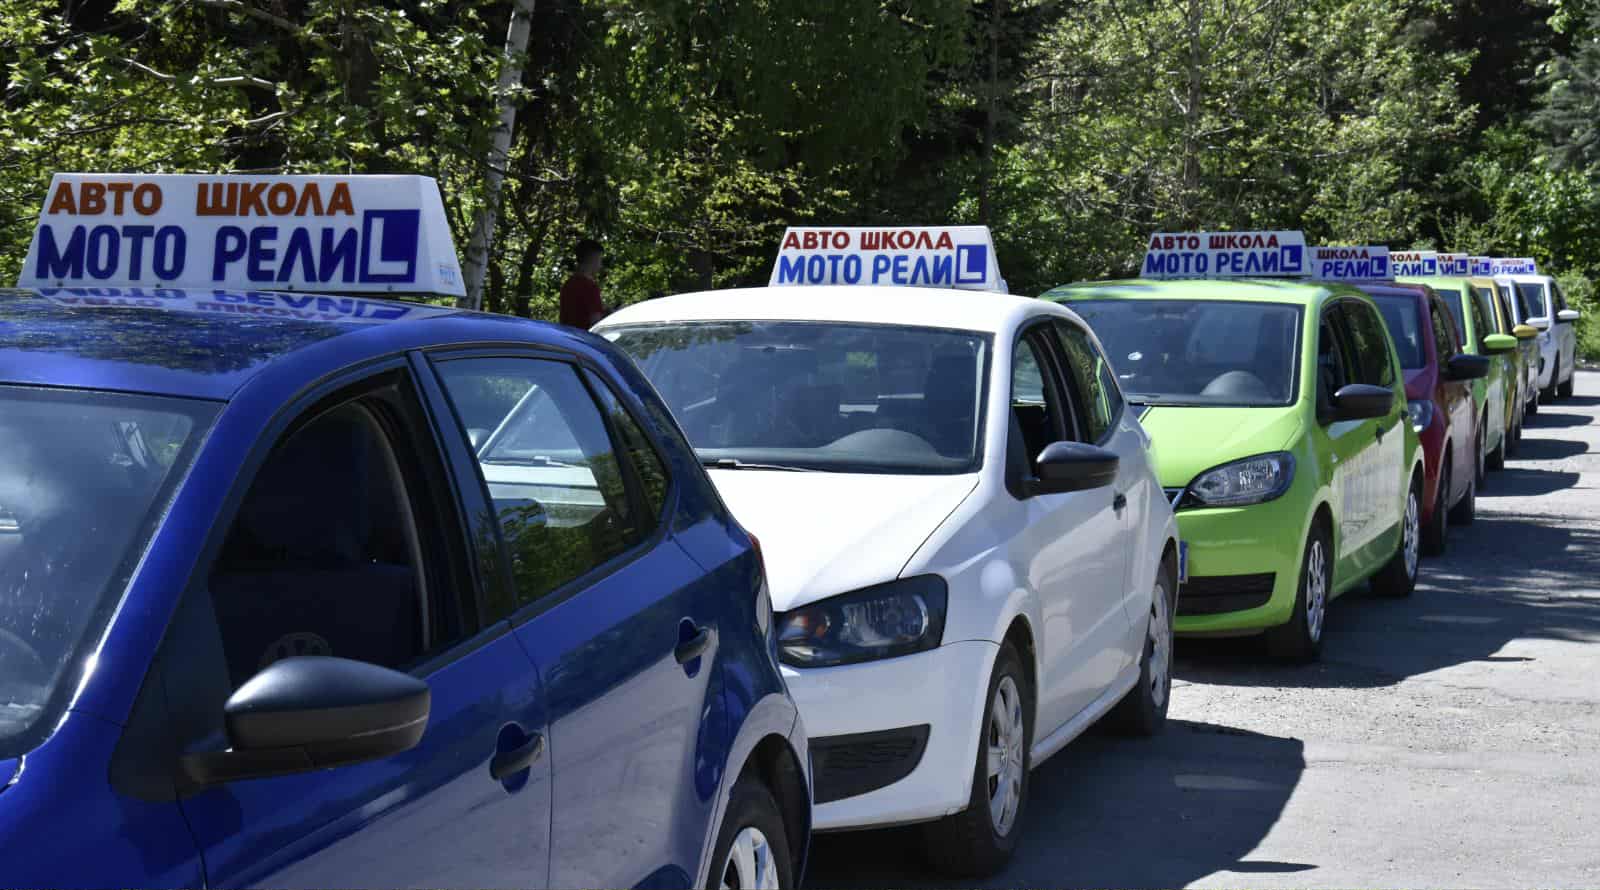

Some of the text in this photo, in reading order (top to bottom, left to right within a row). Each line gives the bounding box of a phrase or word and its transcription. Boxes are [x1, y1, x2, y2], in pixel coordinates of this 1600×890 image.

[47, 182, 356, 217] АВТО ШКОЛА
[782, 230, 955, 251] АВТО ШКОЛА
[1150, 234, 1279, 250] АВТО ШКОЛА
[35, 224, 358, 284] МОТО РЕЛИ
[1146, 252, 1279, 274] МОТО РЕЛИ
[1317, 249, 1369, 260] ШКОЛА
[778, 254, 953, 285] МОТО РЕЛИ
[1322, 261, 1370, 277] РЕЛИ
[1392, 263, 1421, 276] ЕЛИ
